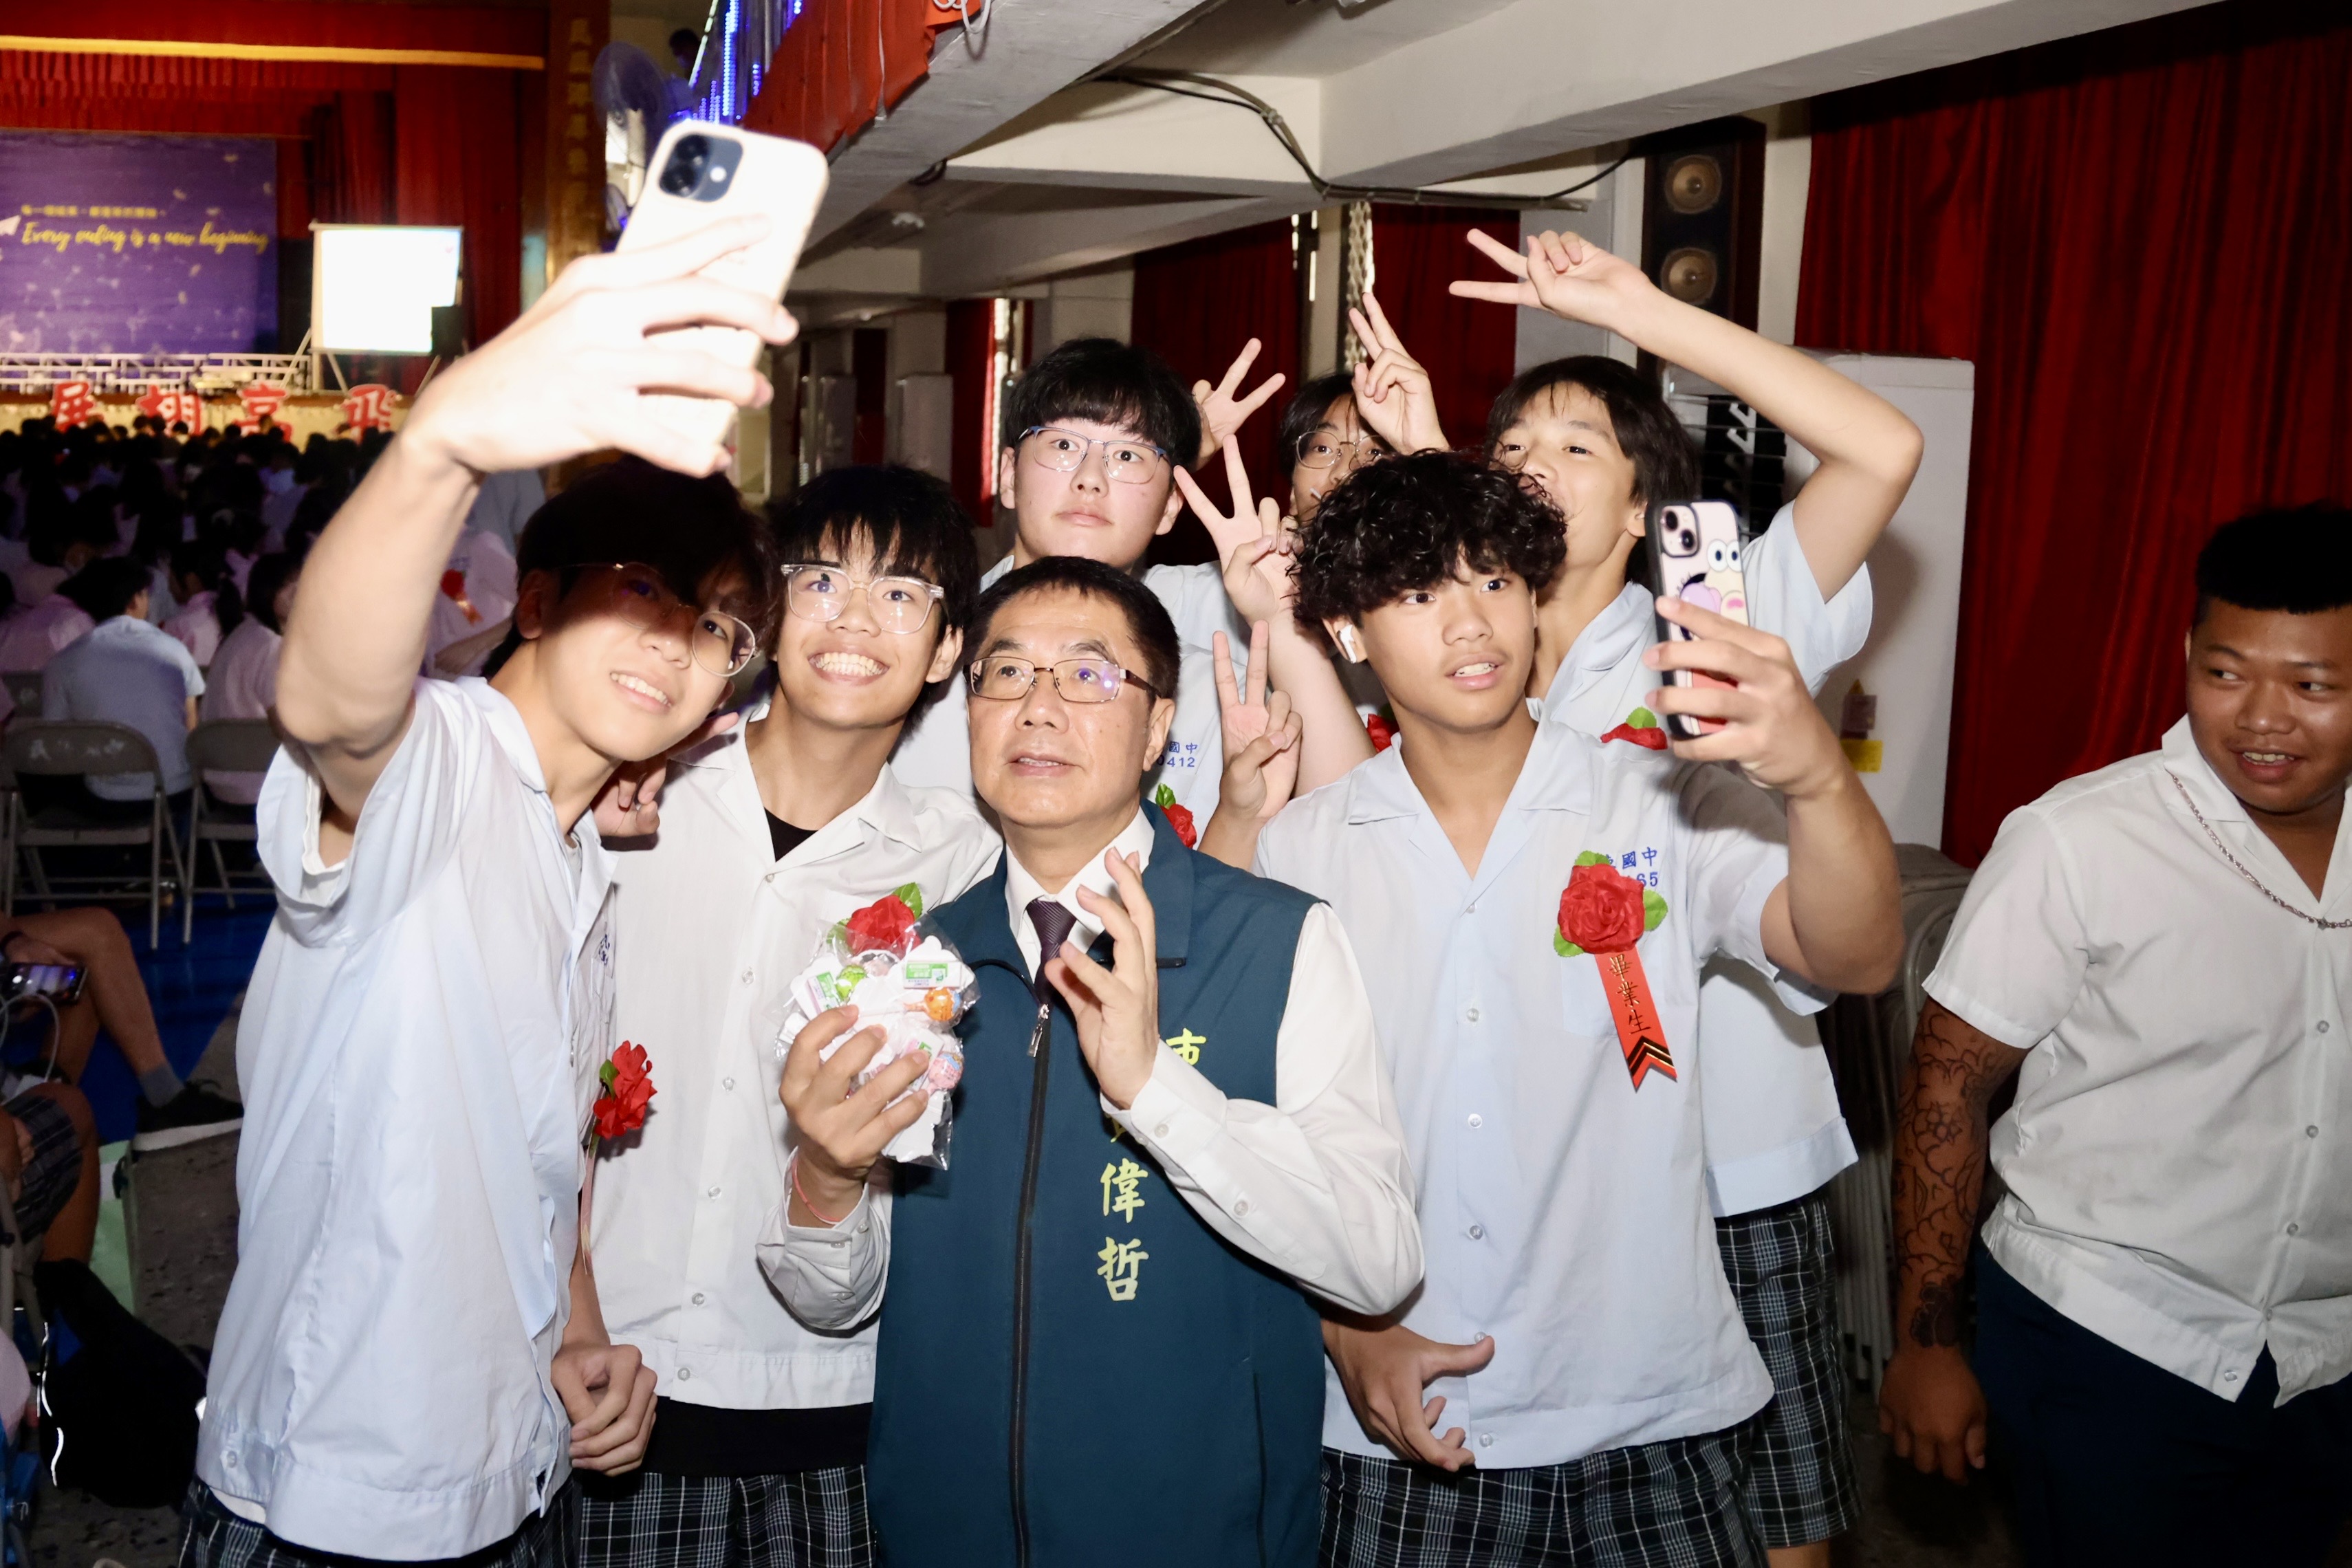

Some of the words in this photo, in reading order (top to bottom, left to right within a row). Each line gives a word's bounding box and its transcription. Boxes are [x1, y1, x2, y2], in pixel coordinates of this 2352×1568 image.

[1628, 871, 1658, 887] 65
[1608, 953, 1651, 1035] 畢業生
[1098, 1111, 1149, 1301] 偉哲
